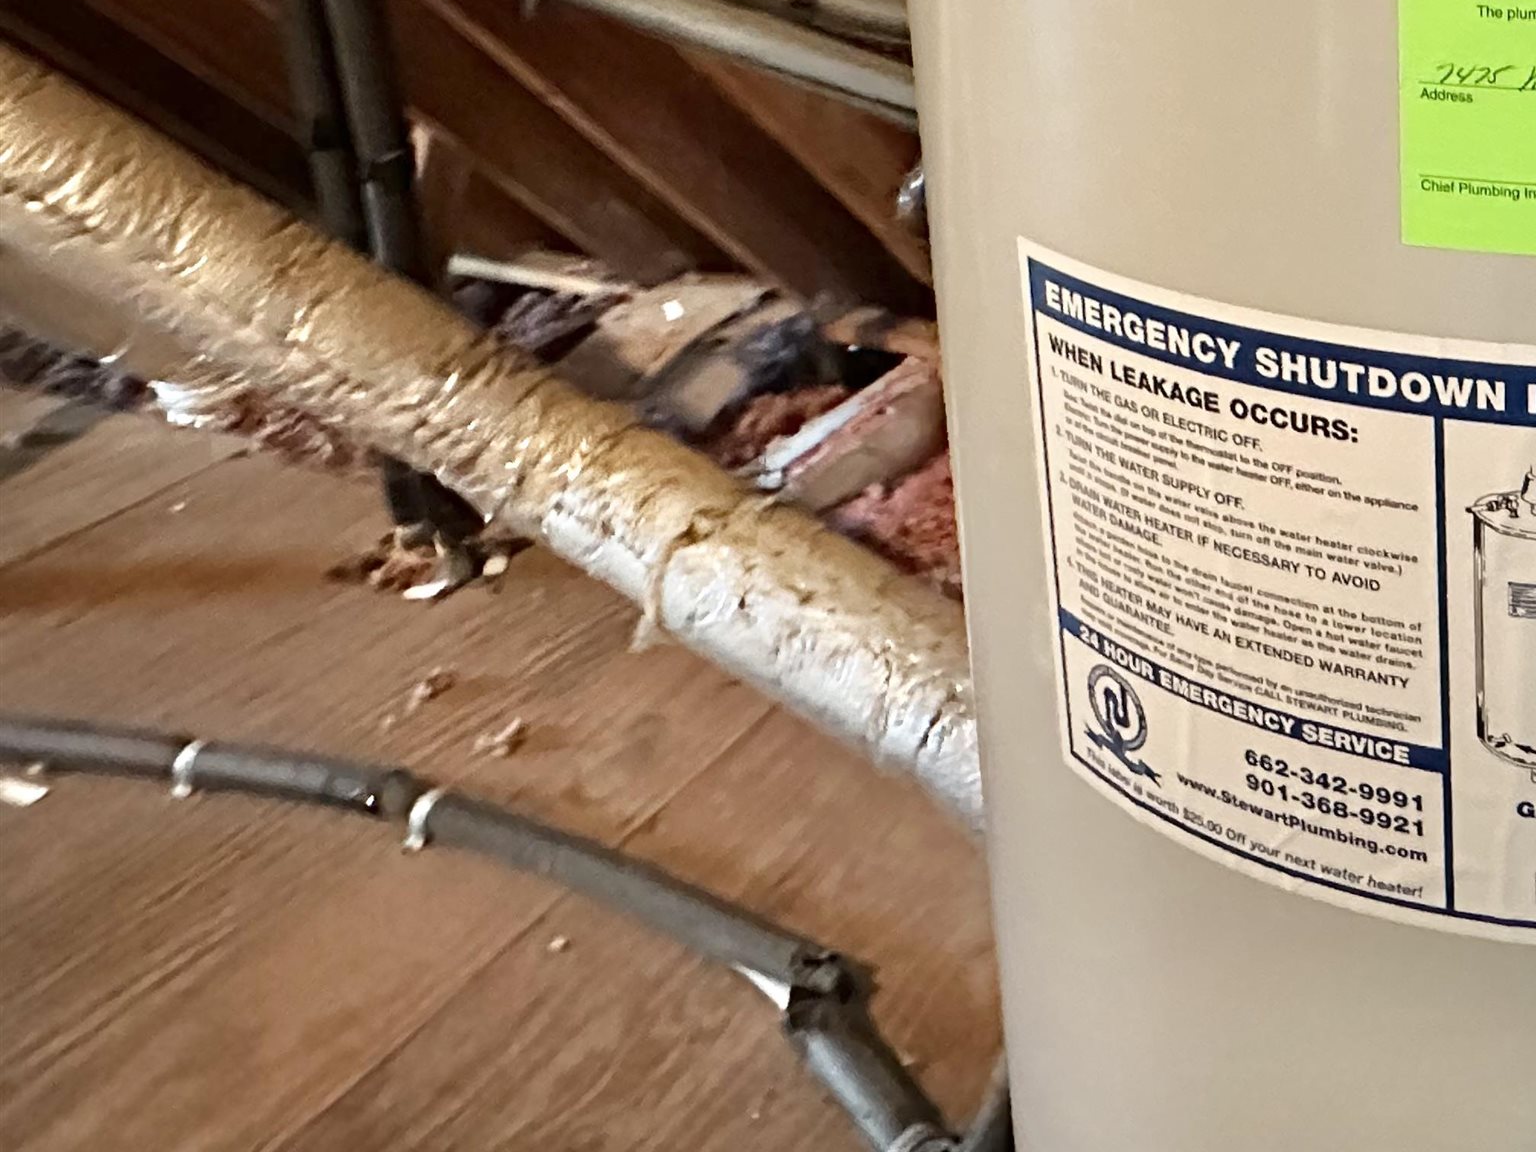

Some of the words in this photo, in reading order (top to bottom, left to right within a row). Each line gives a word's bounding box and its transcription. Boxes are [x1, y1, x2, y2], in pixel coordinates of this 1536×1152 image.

[1477, 5, 1502, 19] The
[1420, 87, 1473, 104] Address
[1420, 179, 1454, 193] Chief
[1459, 183, 1520, 200] Plumbing
[1044, 279, 1241, 369] EMERGENCY
[1255, 348, 1507, 411] SHUTDOWN
[1047, 331, 1103, 376] WHEN
[1111, 360, 1221, 414] LEAKAGE
[1230, 398, 1359, 443] OCCURS:
[1091, 383, 1111, 402] THE
[1114, 395, 1138, 414] GAS
[1141, 405, 1160, 423] OR
[1163, 412, 1228, 443] ELECTRIC
[1232, 433, 1263, 451] OFF.
[1095, 446, 1116, 464] THE
[1119, 455, 1159, 483] WATER
[1162, 473, 1211, 500] SUPPLY
[1214, 491, 1245, 510] OFF.
[1253, 457, 1268, 469] the
[1272, 462, 1293, 475] OFF
[1295, 469, 1342, 485] position.
[1270, 476, 1293, 490] OFF,
[1295, 483, 1325, 496] either
[1328, 489, 1342, 498] on
[1343, 491, 1361, 502] the
[1364, 498, 1419, 512] appliance
[1103, 496, 1142, 521] WATER
[1144, 514, 1193, 541] HEATER
[1198, 535, 1210, 547] IF
[1213, 539, 1300, 574] NECESSARY
[1304, 565, 1326, 580] TO
[1332, 572, 1381, 592] AVOID
[1109, 513, 1163, 547] DAMAGE.
[1258, 523, 1276, 534] the
[1279, 529, 1311, 543] water
[1315, 536, 1352, 551] heater
[1357, 546, 1419, 563] clockwise
[1256, 536, 1271, 546] off
[1274, 542, 1292, 555] the
[1295, 546, 1323, 561] main
[1326, 553, 1359, 567] water
[1363, 561, 1402, 576] valve.)
[1101, 576, 1143, 605] HEATER
[1146, 601, 1172, 619] MAY
[1176, 612, 1209, 635] HAVE
[1213, 628, 1232, 644] AN
[1235, 637, 1314, 667] EXTENDED
[1319, 658, 1409, 688] WARRANTY
[1252, 598, 1271, 611] the
[1274, 604, 1301, 619] hose
[1305, 613, 1317, 623] to
[1332, 621, 1366, 633] lower
[1371, 627, 1422, 645] location
[1323, 604, 1334, 614] at
[1338, 609, 1357, 620] the
[1361, 613, 1405, 628] bottom
[1409, 623, 1421, 632] of
[1283, 619, 1312, 636] Open
[1325, 632, 1344, 643] hot
[1348, 637, 1381, 650] water
[1384, 644, 1423, 658] faucet
[1301, 638, 1314, 648] as
[1317, 642, 1336, 654] the
[1338, 648, 1372, 661] water
[1375, 655, 1416, 670] drains.
[1079, 625, 1100, 649] 24
[1103, 641, 1155, 680] HOUR
[1159, 670, 1296, 734] EMERGENCY
[1301, 723, 1410, 764] SERVICE
[1254, 687, 1283, 702] CALL
[1286, 695, 1338, 716] STEWART
[1365, 705, 1421, 722] technician
[1244, 749, 1424, 812] 662-342-9991
[1176, 773, 1428, 864] www.StewartPlumbing.com
[1246, 773, 1425, 837] 901-368-9921
[1225, 827, 1247, 846] Off
[1250, 839, 1280, 857] your
[1284, 851, 1316, 871] next
[1320, 863, 1364, 885] water
[1367, 875, 1423, 899] heater!
